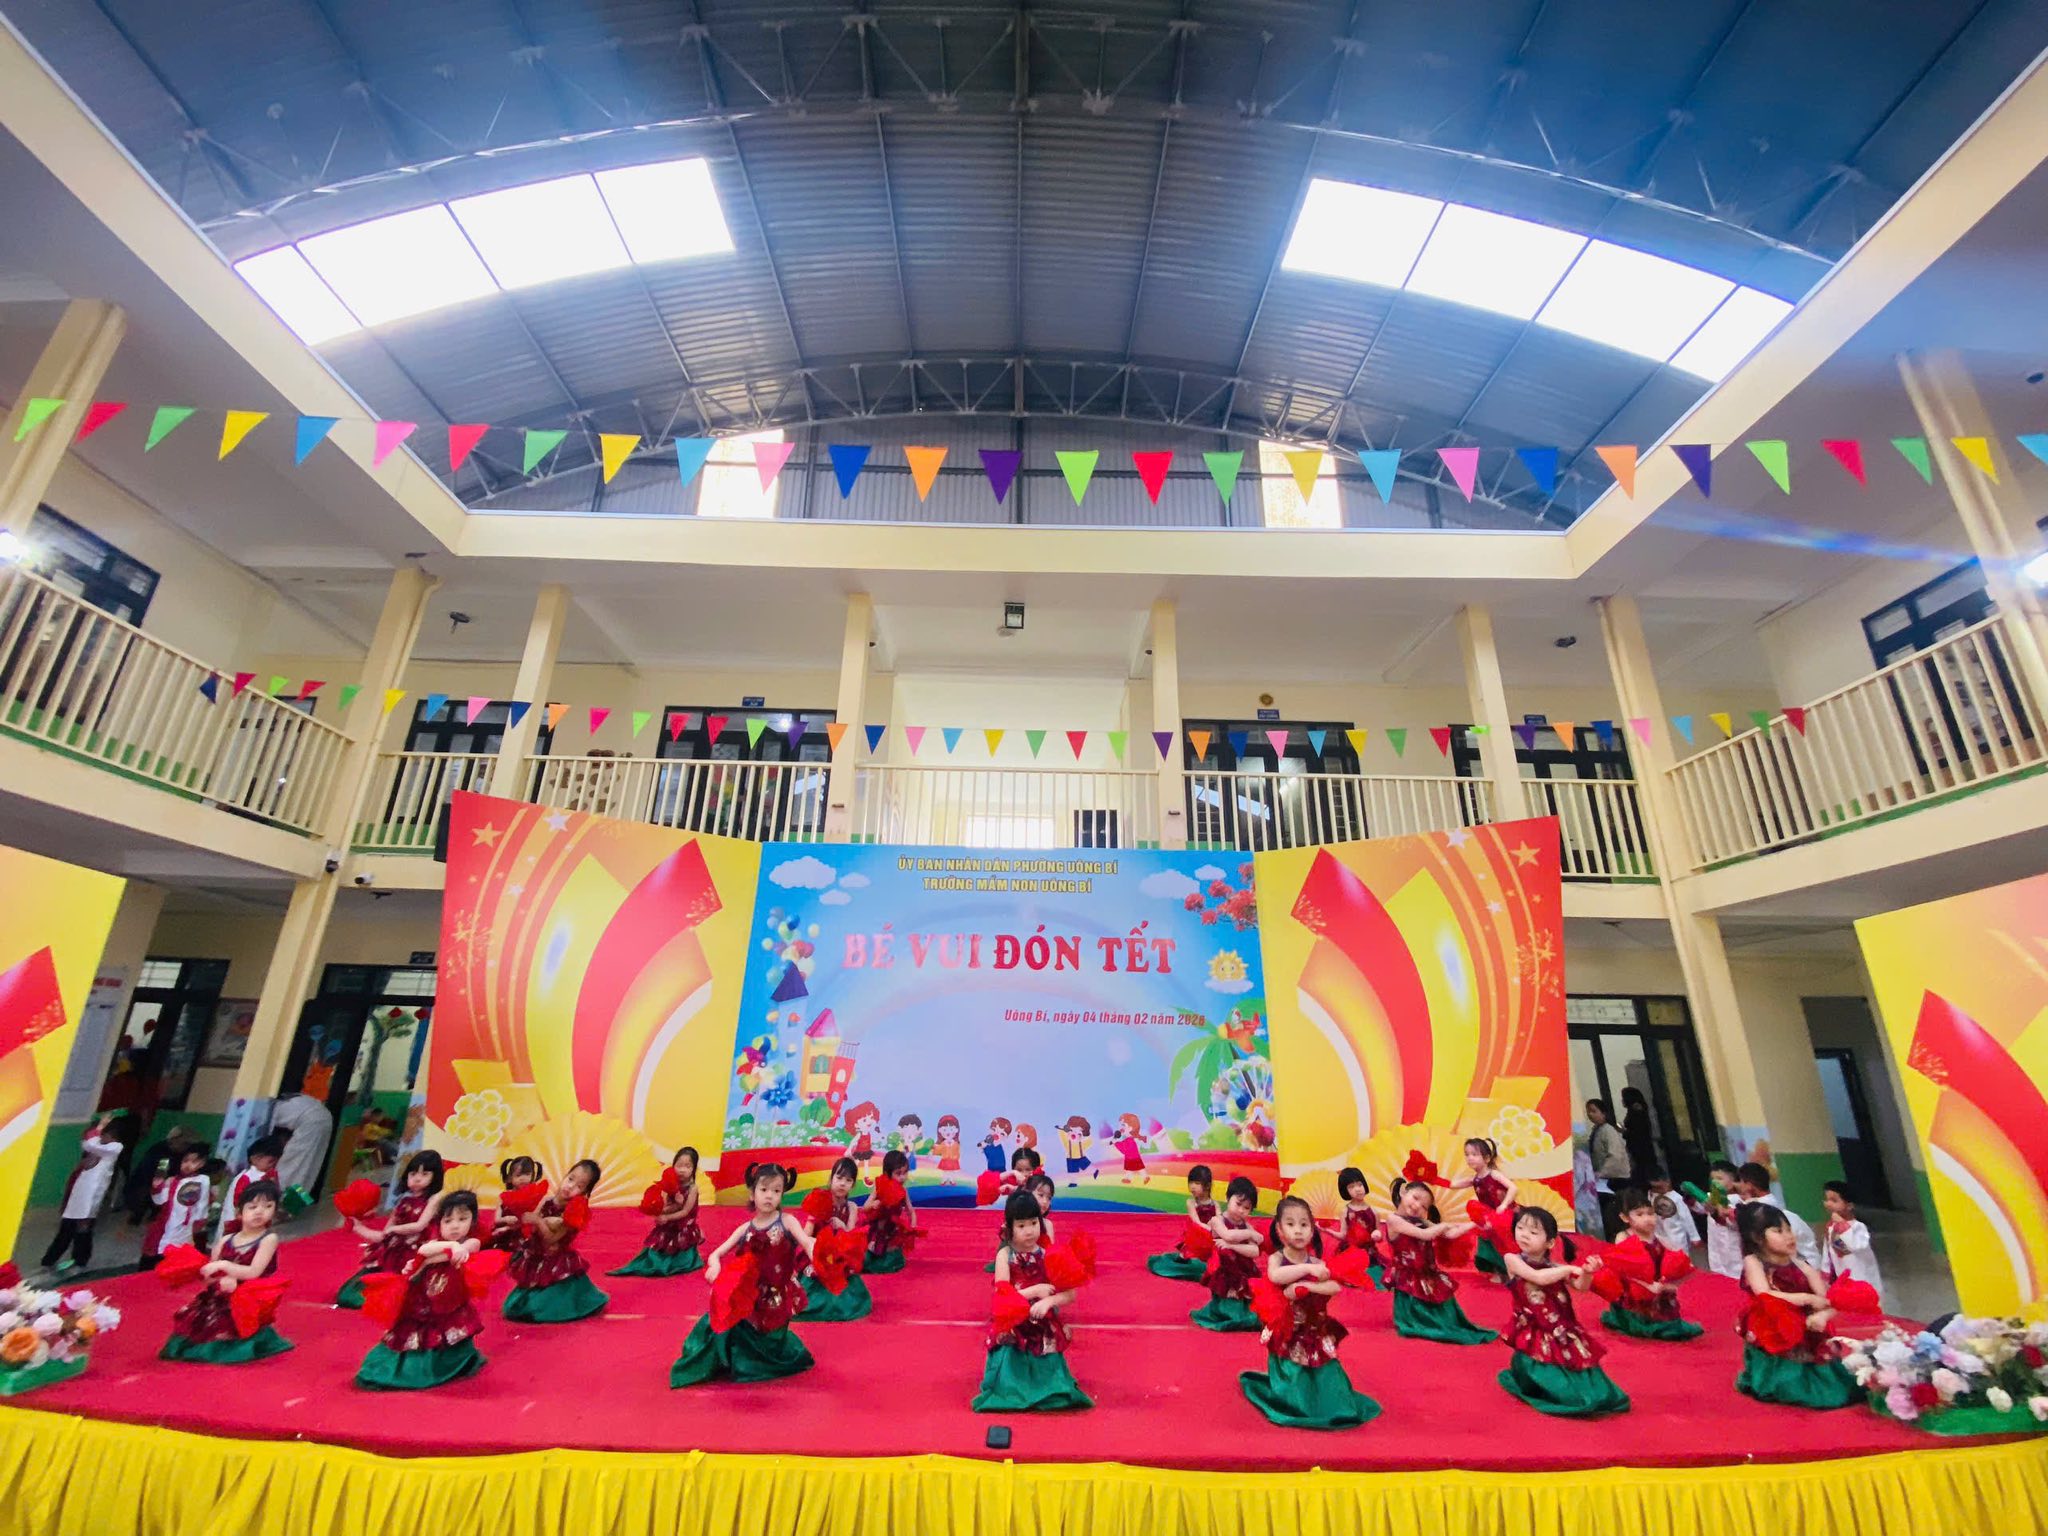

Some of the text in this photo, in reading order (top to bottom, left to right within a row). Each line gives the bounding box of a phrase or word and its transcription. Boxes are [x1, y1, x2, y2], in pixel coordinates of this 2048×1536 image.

[917, 858, 943, 870] BAN
[946, 856, 980, 871] NHÂN
[983, 857, 1009, 872] DÂN
[1013, 858, 1064, 873] PHƯỜNG
[1066, 859, 1101, 874] UÔNG
[1104, 859, 1118, 874] BÍ
[923, 875, 1092, 893] TRƯỜNG MẦM NON UÔNG BÍ
[842, 920, 1176, 973] BÉ VUI ĐÓN TẾT
[1005, 1009, 1032, 1023] Uông
[1035, 1010, 1049, 1023] Bí,
[1053, 1011, 1080, 1024] ngày
[1083, 1011, 1096, 1022] 04
[1099, 1012, 1130, 1025] tháng
[1134, 1012, 1148, 1024] 02
[1150, 1013, 1174, 1024] năm
